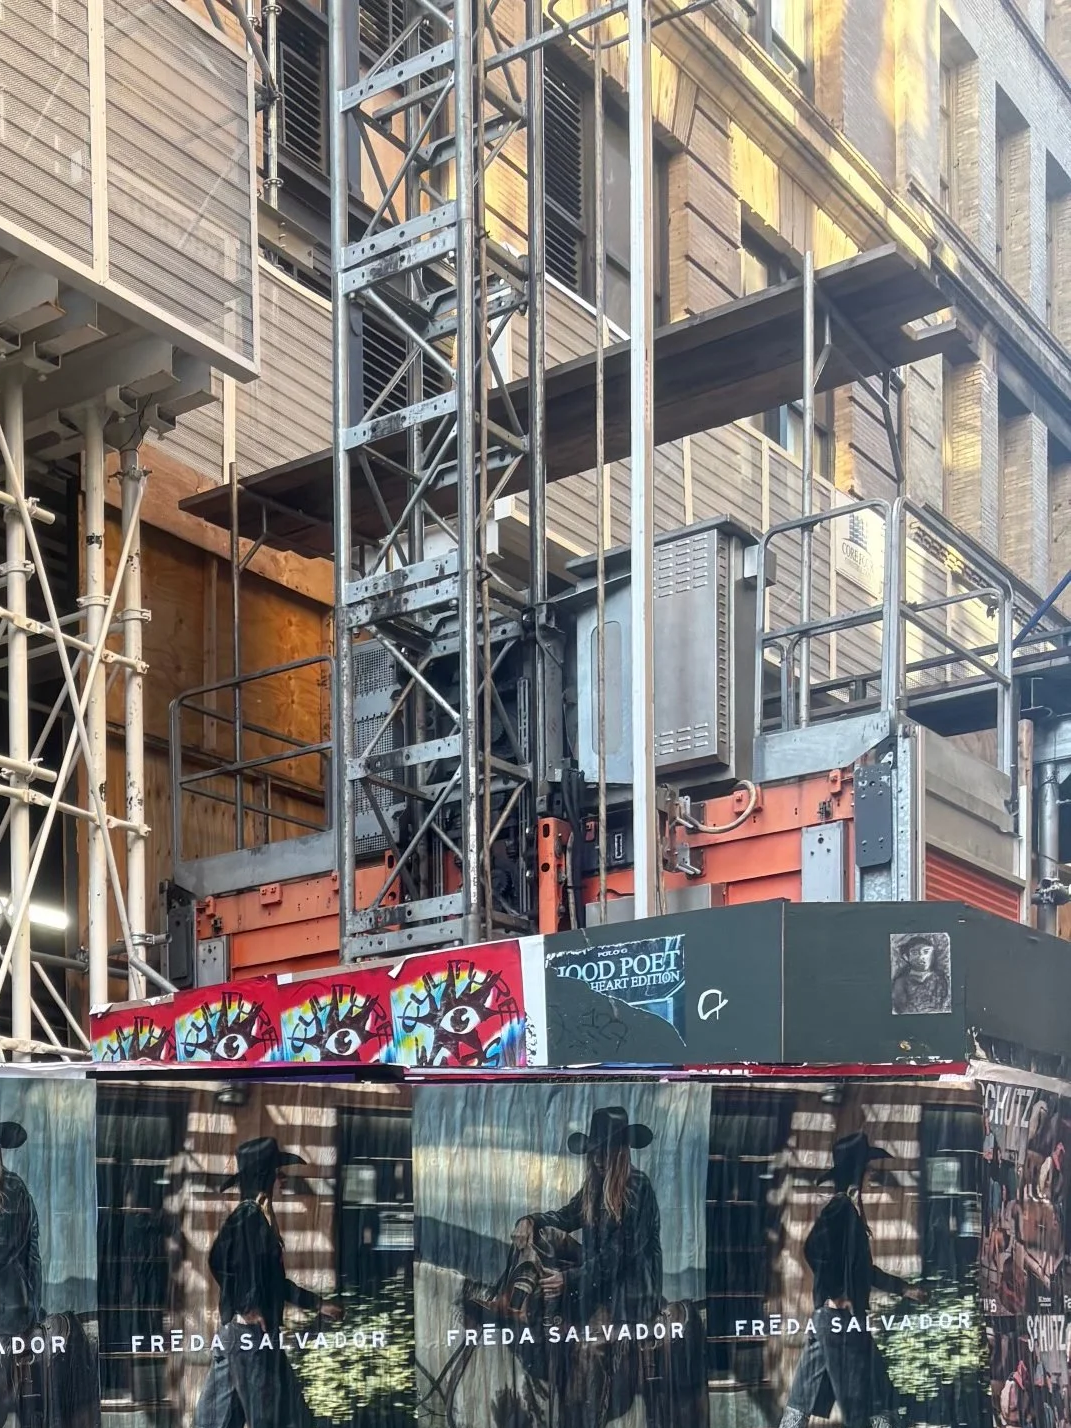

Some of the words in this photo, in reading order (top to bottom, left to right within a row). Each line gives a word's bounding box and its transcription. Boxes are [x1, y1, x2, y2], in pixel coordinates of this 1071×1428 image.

[620, 950, 680, 977] POET
[590, 978, 630, 992] HEART
[631, 971, 680, 988] EDITION
[548, 1322, 684, 1344] SALVADOR
[831, 1314, 971, 1333] SALVADOR
[1027, 1315, 1066, 1352] SCHUTZ
[239, 1331, 386, 1351] SALVADOR
